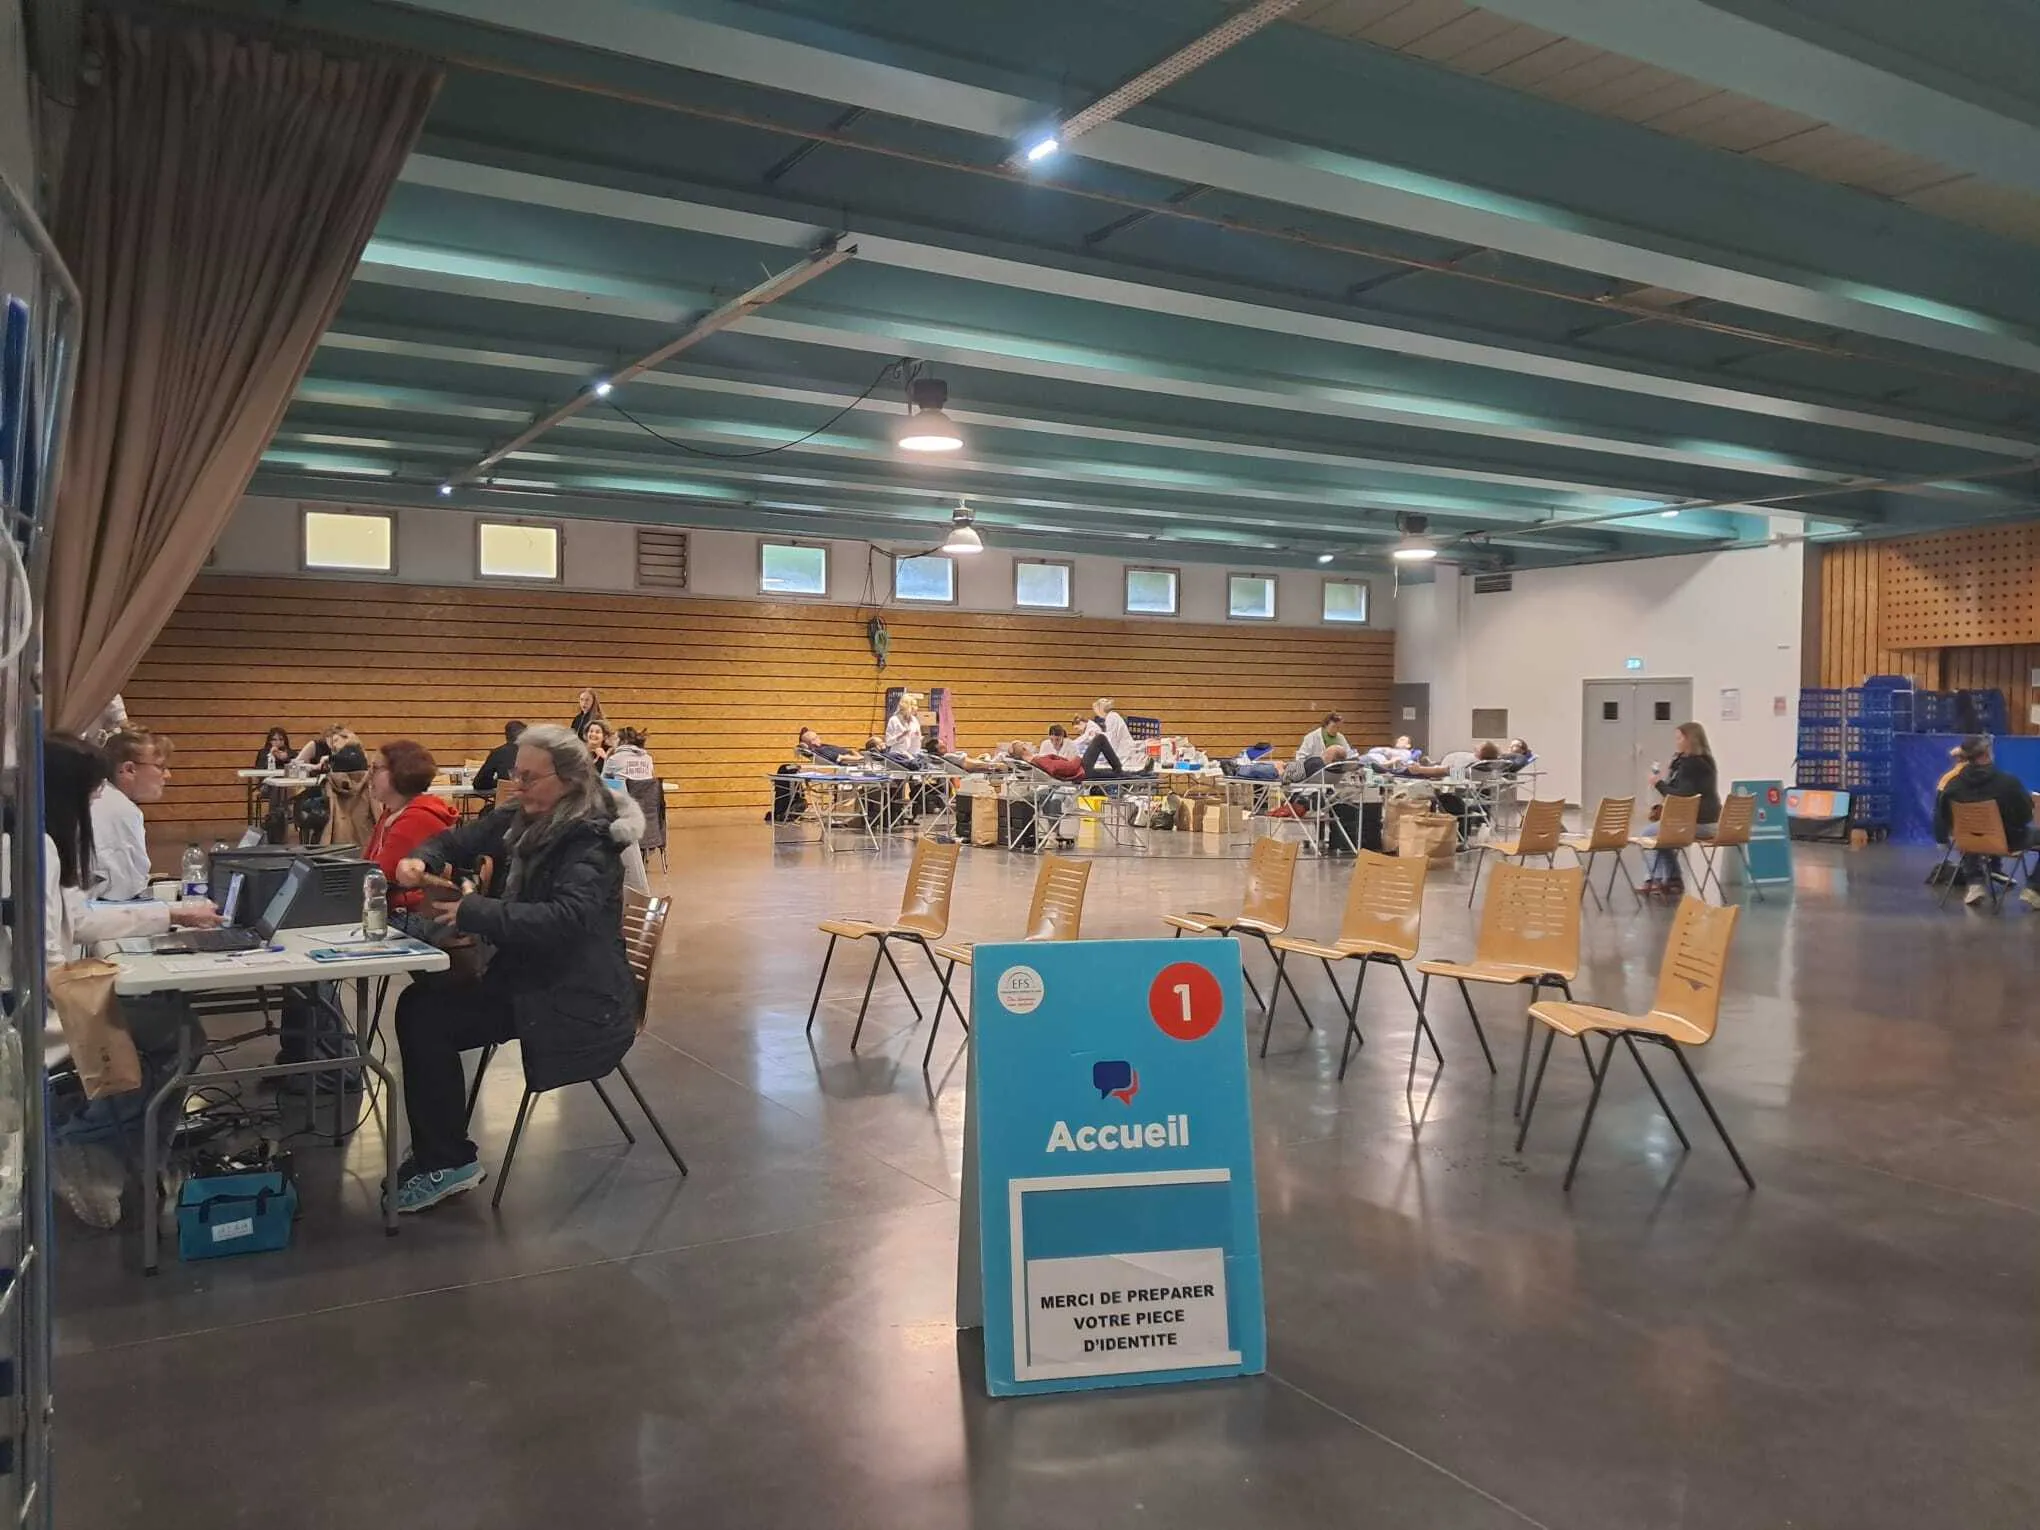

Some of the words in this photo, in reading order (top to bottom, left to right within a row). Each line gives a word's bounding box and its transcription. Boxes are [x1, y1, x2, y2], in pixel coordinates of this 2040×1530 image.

[1012, 979, 1030, 989] EFS
[1173, 983, 1192, 1021] 1
[1045, 1114, 1190, 1153] Accueil
[1040, 1293, 1094, 1309] MERCI
[1100, 1291, 1121, 1305] DE
[1127, 1284, 1215, 1303] PREPARER
[1074, 1313, 1131, 1330] VOTRE
[1136, 1309, 1185, 1325] PIECE
[1084, 1332, 1178, 1352] D'IDENTITE
